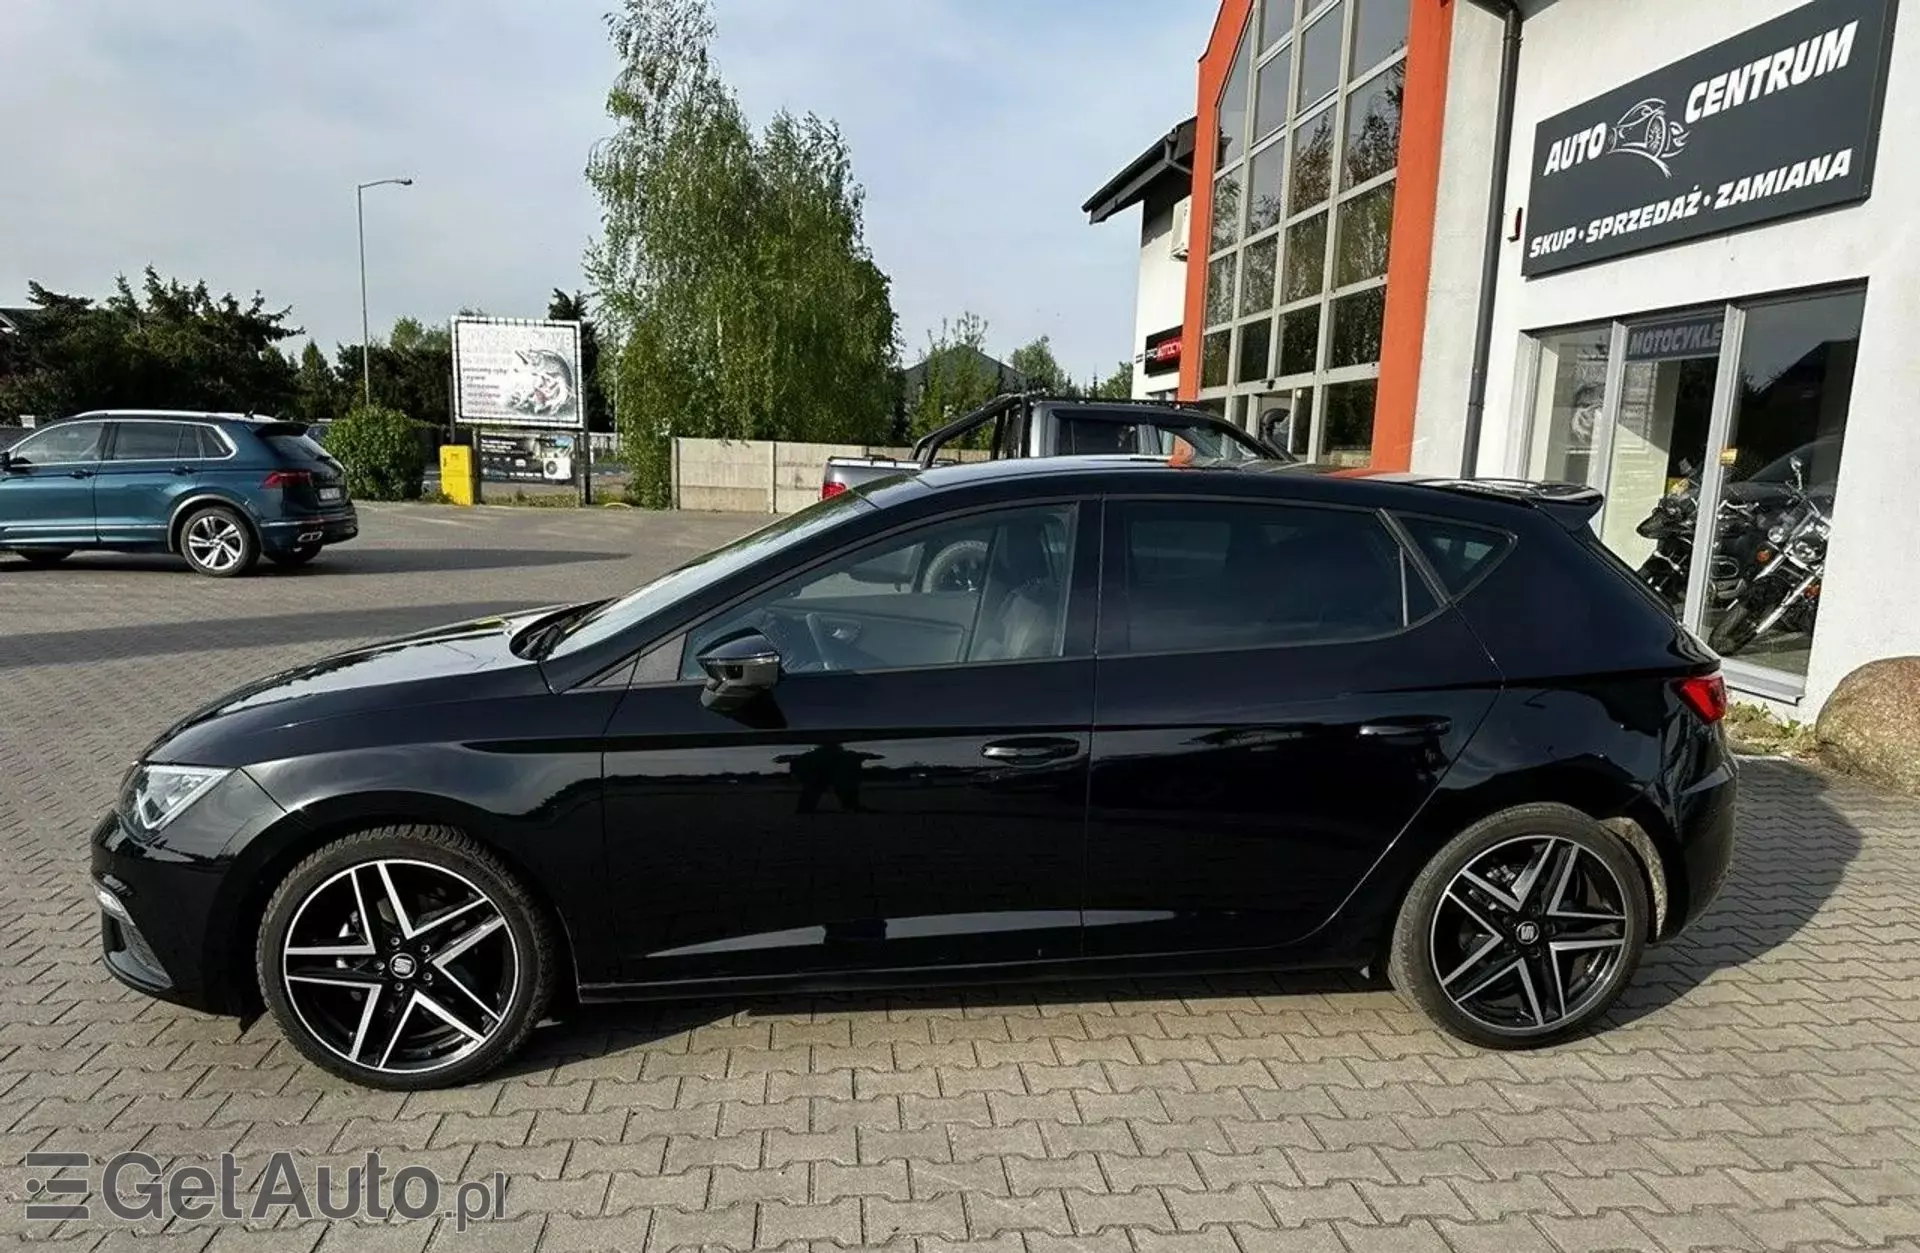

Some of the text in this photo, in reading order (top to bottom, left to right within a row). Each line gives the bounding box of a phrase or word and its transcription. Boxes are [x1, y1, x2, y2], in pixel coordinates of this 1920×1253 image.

[1543, 20, 1859, 177] AUTO CENTRUM
[1528, 148, 1853, 259] SKUP SPRZEDAŻ ZAMIANA
[1628, 322, 1723, 356] MOTOCYKLE
